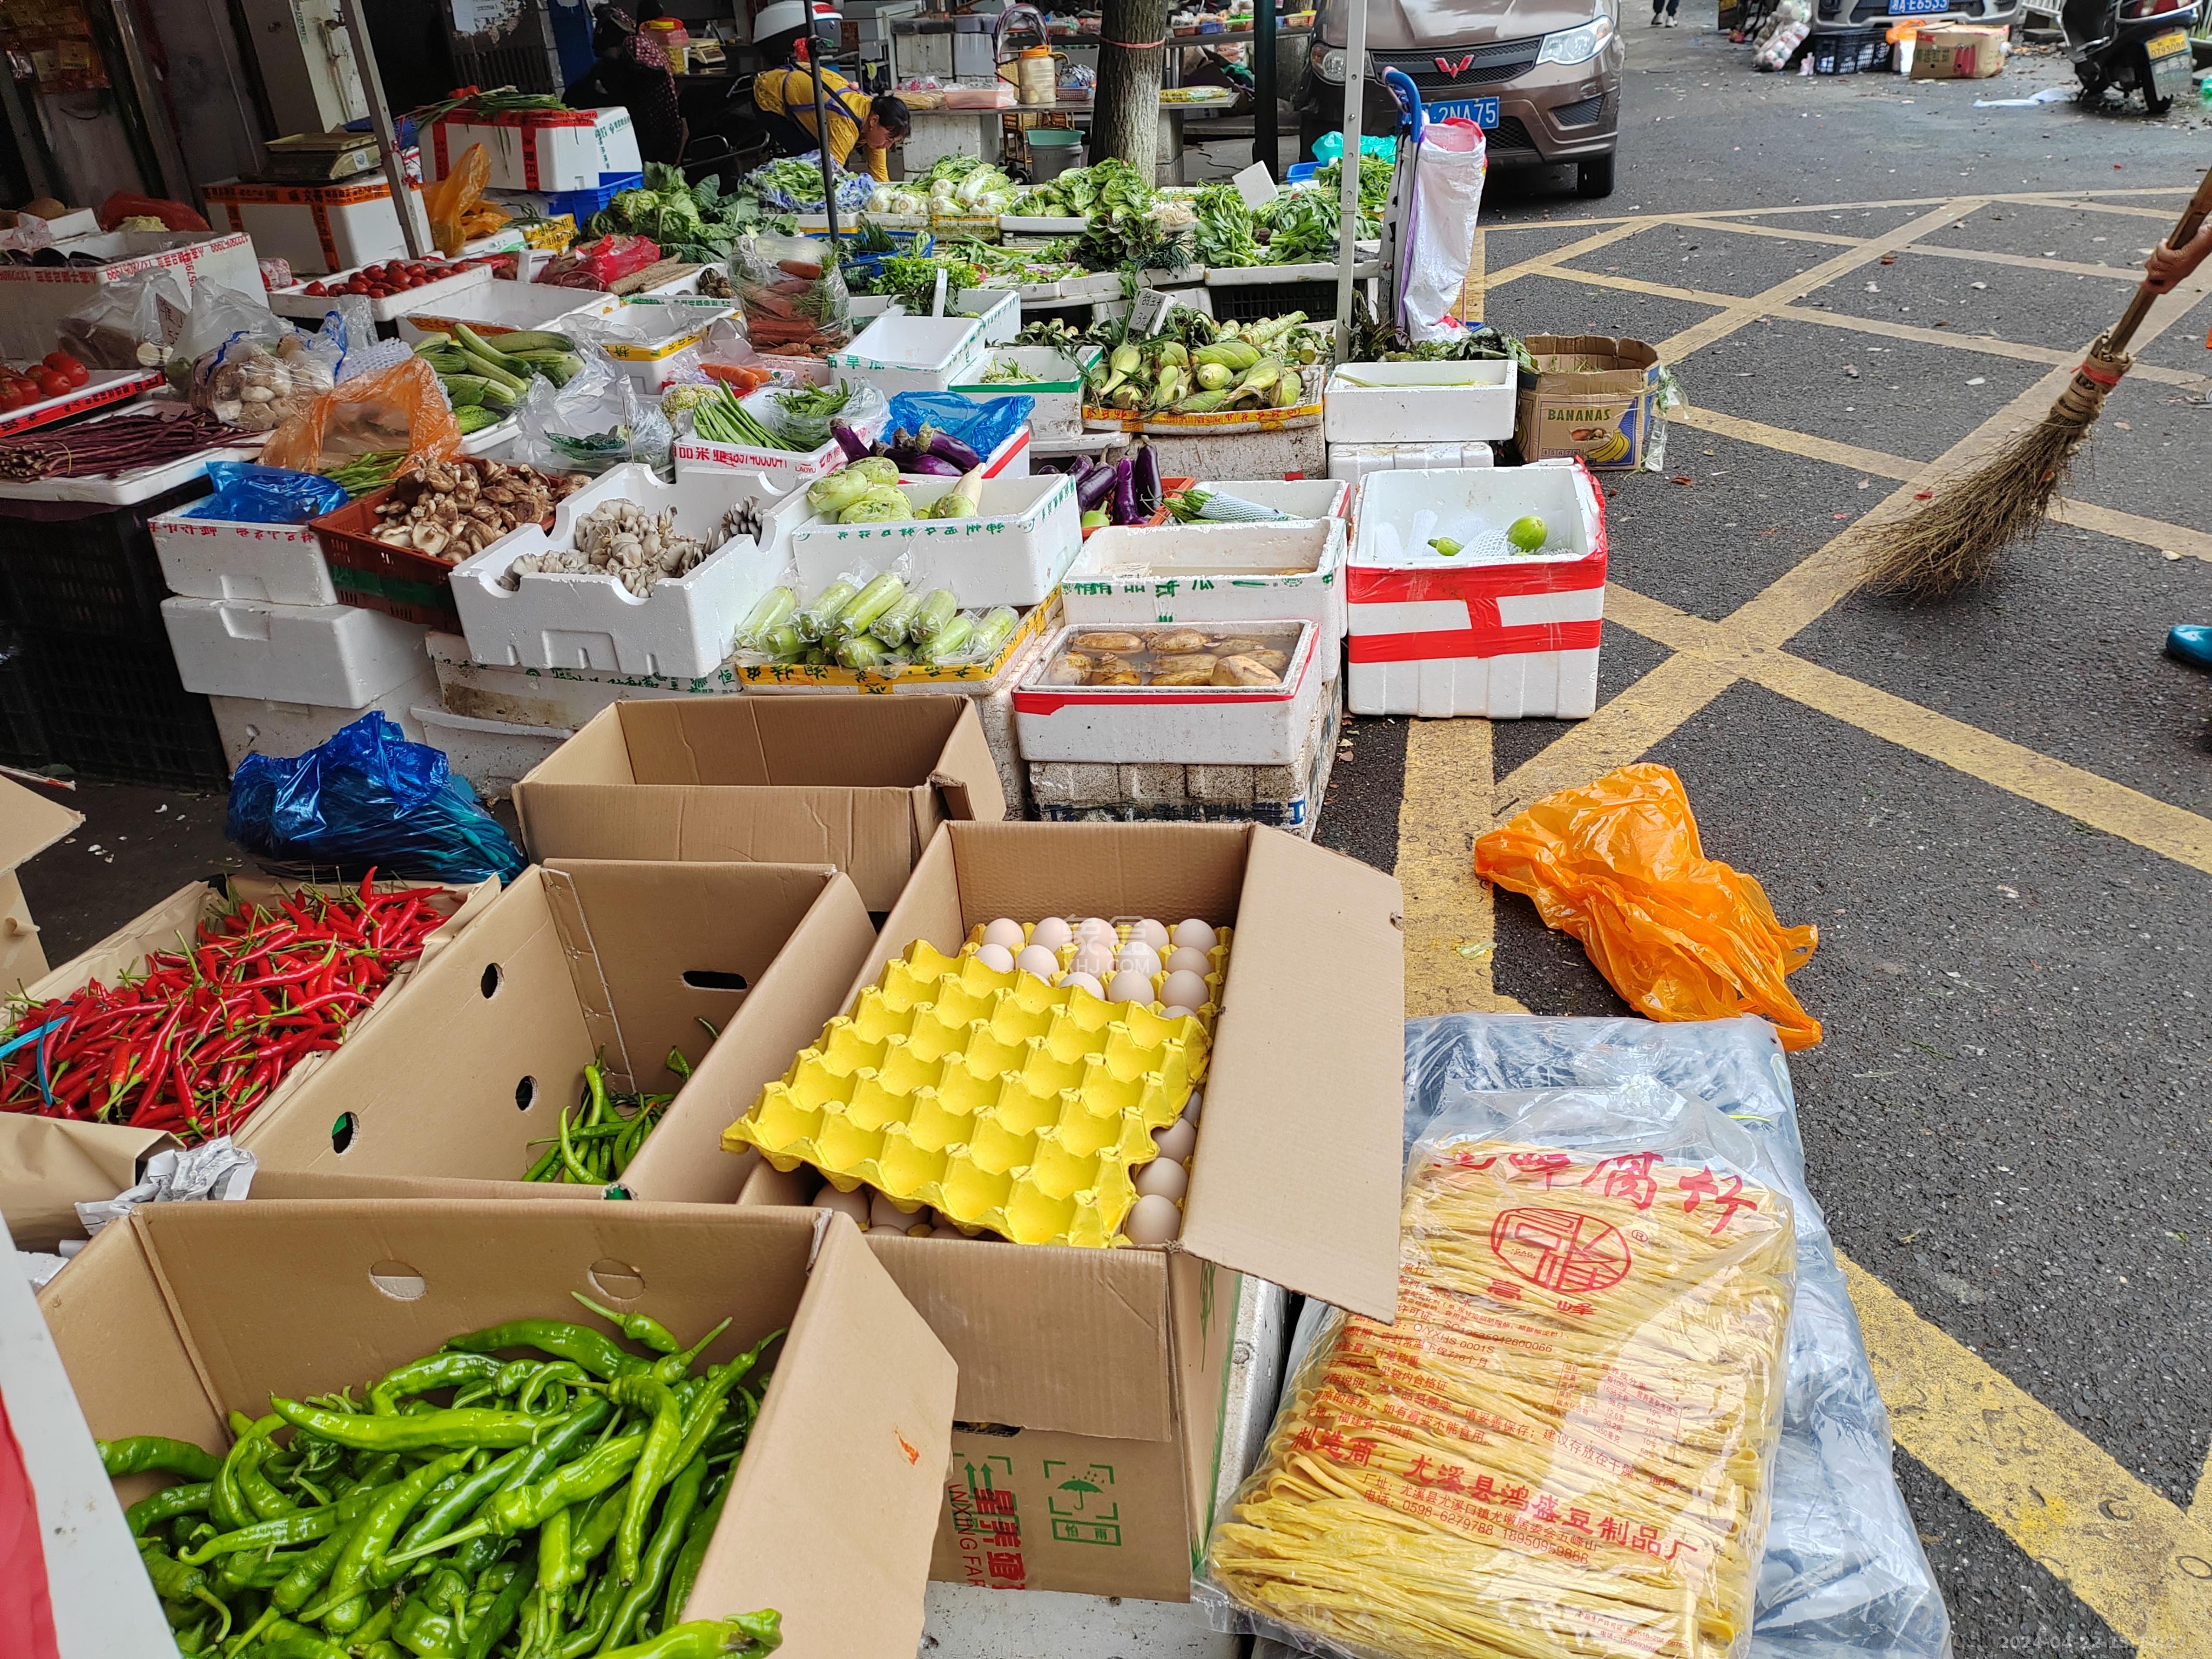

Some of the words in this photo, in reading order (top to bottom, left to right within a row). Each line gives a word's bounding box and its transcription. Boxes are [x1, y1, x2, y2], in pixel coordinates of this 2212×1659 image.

[1136, 312, 1148, 326] 3元
[1547, 408, 1611, 422] BANANAS
[1403, 1262, 1426, 1276] 腐竹
[1459, 1340, 1495, 1354] 0001S
